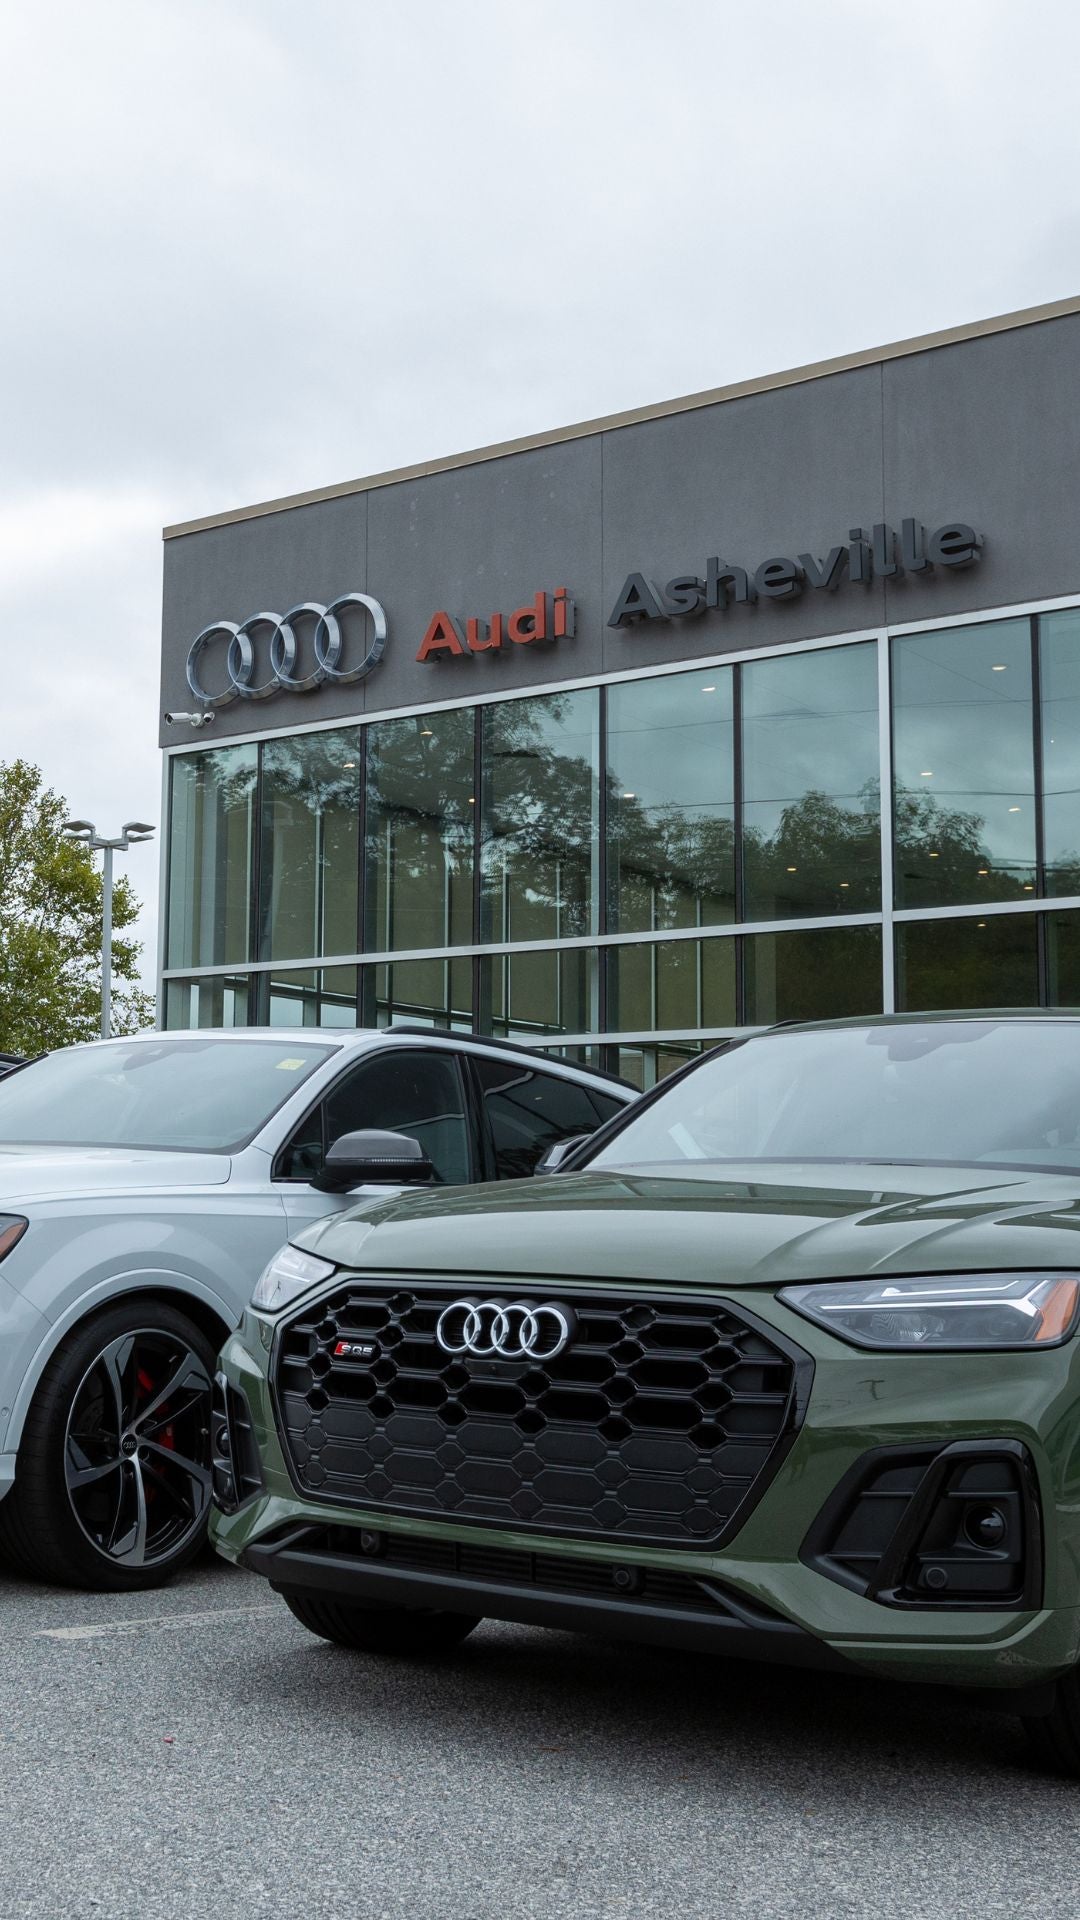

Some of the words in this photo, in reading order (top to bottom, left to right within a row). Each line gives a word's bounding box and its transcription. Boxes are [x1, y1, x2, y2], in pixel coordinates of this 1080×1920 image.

[416, 587, 574, 664] Audi
[607, 517, 982, 628] Asheville
[341, 1344, 373, 1356] SQ5
